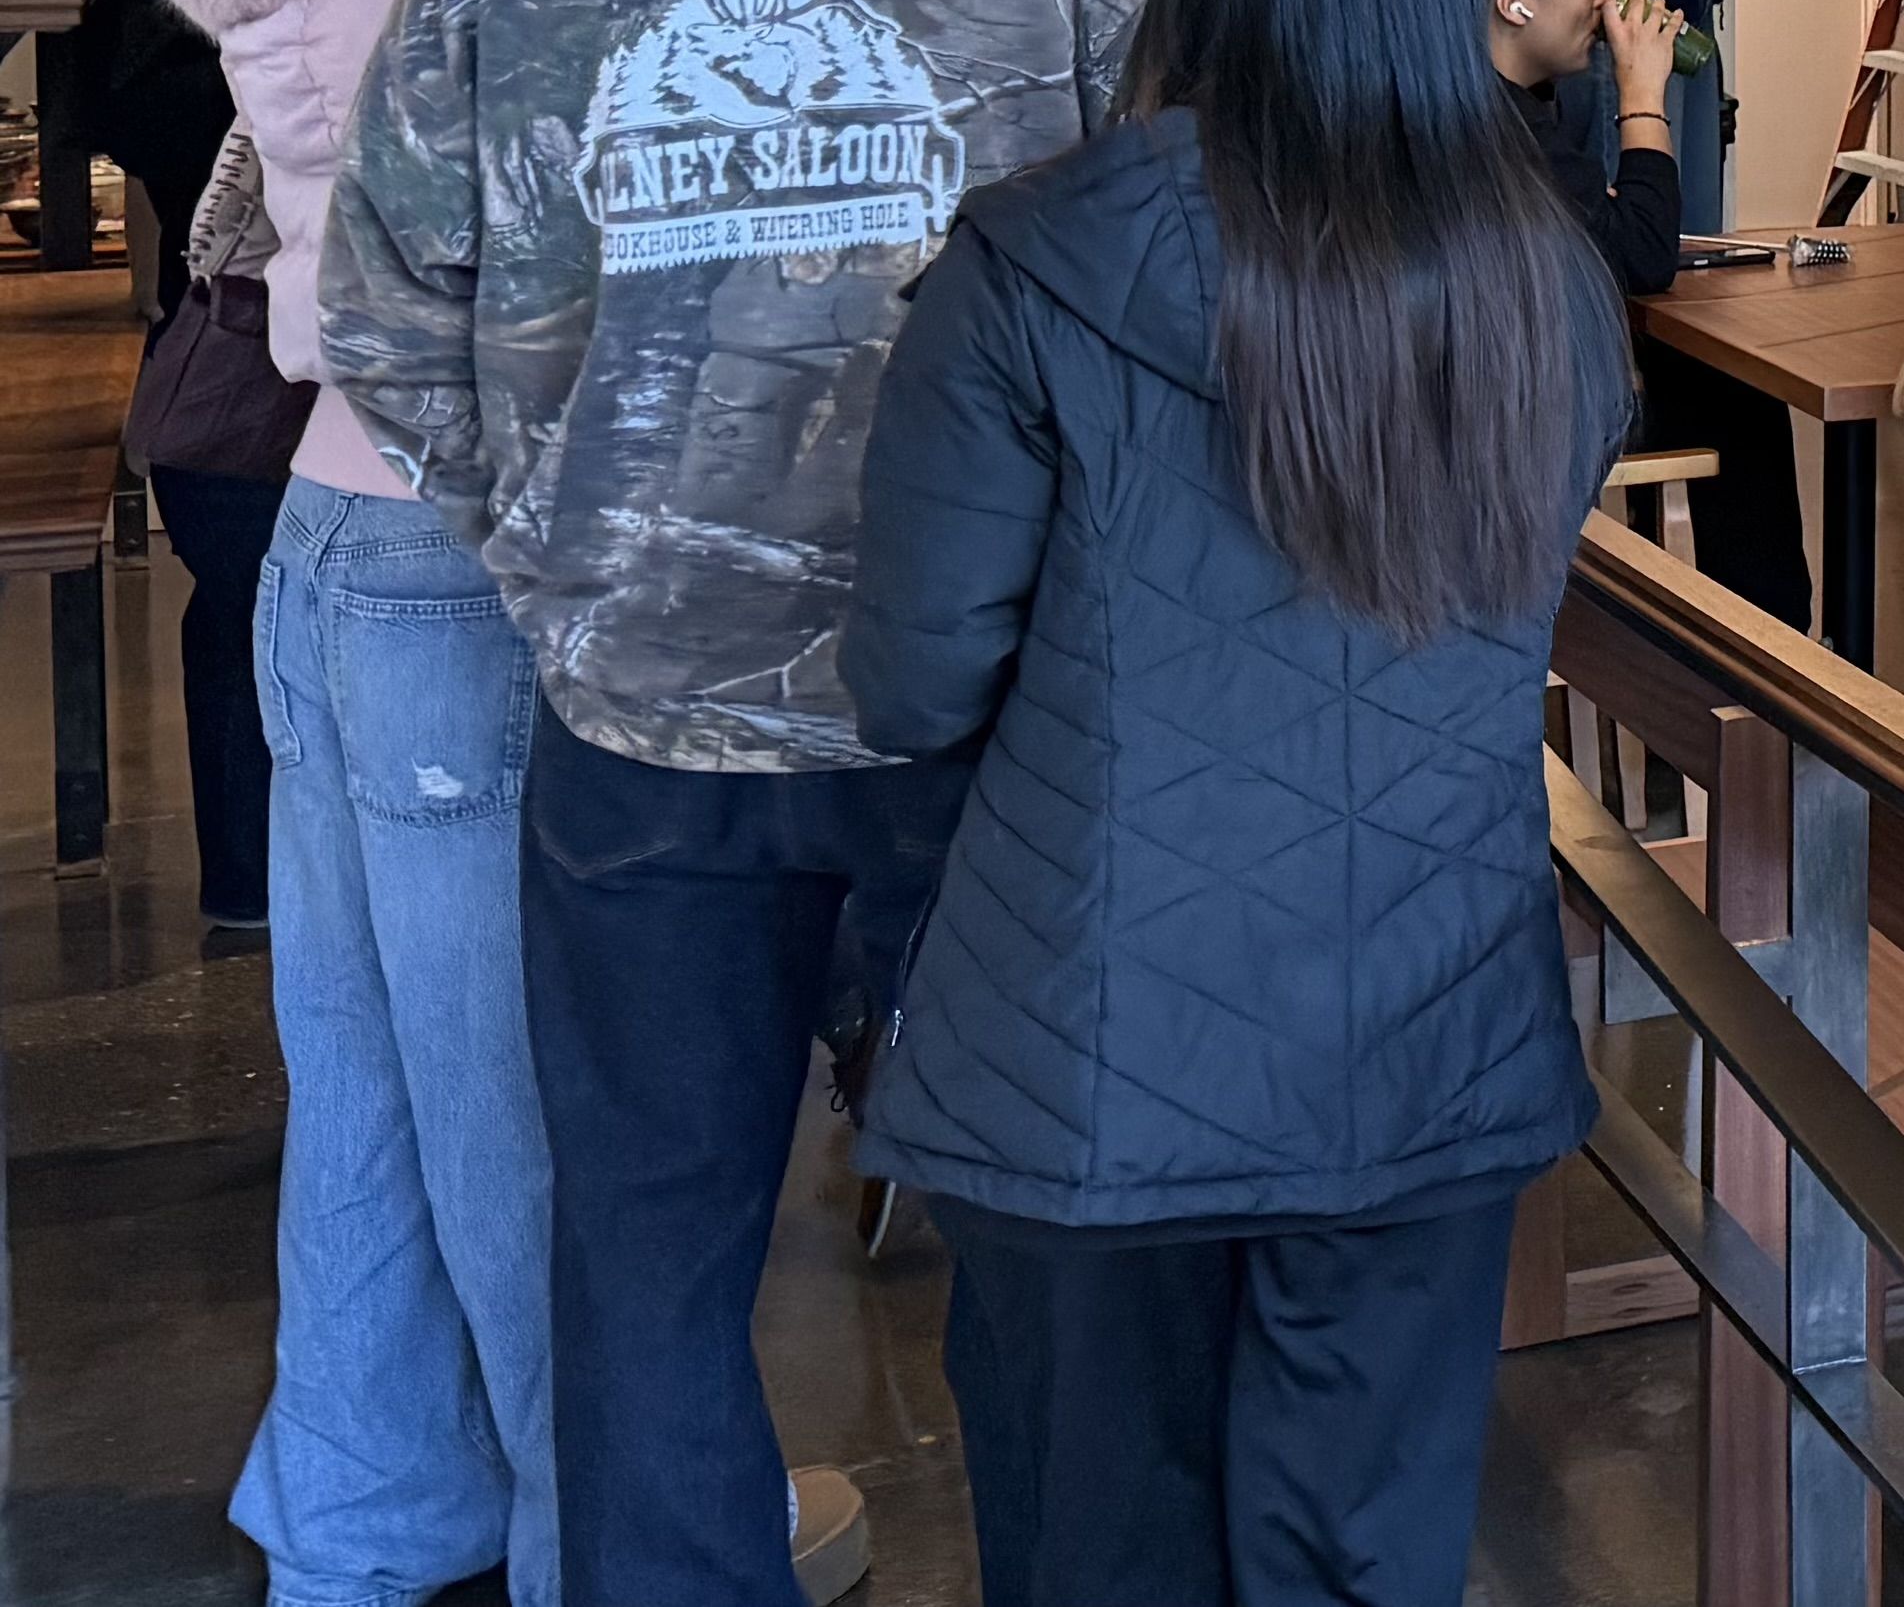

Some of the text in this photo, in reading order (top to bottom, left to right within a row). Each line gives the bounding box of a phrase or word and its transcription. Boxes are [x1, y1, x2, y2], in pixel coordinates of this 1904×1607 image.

[602, 123, 929, 212] LNEY SALOON
[725, 218, 741, 244] &
[861, 201, 909, 232] HOLE
